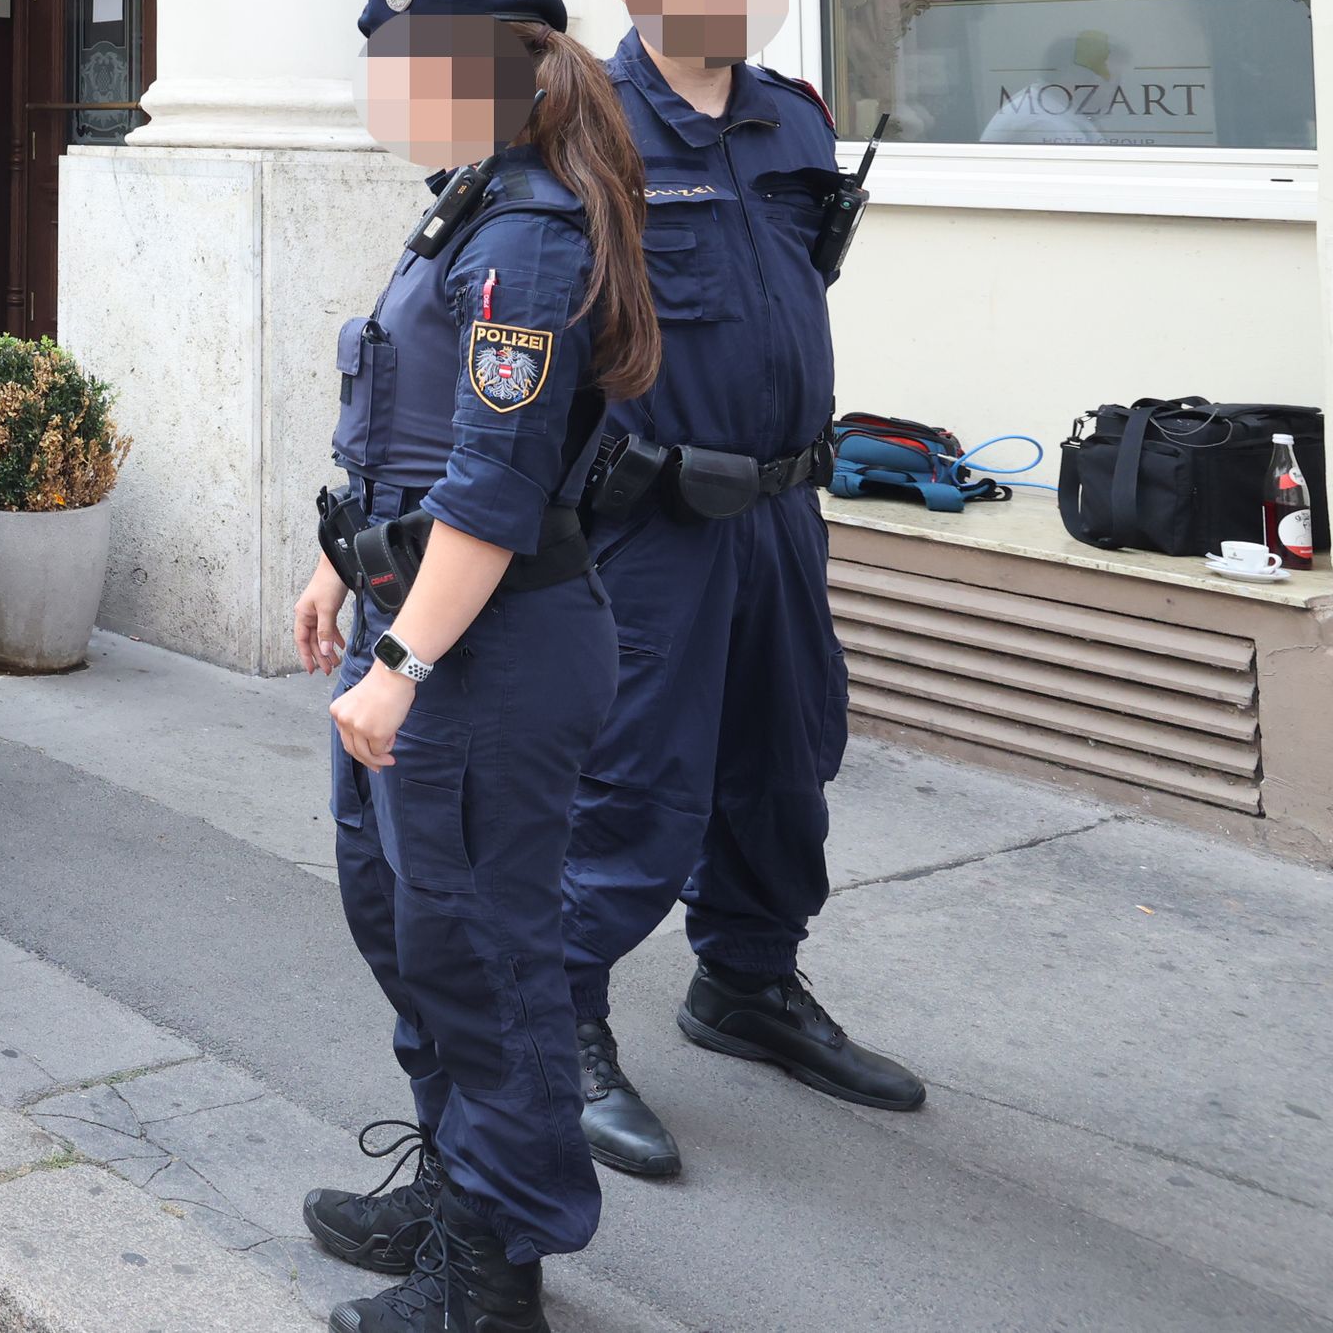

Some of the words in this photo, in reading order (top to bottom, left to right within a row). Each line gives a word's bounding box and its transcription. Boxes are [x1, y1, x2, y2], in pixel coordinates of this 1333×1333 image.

[998, 83, 1206, 116] MOZART
[635, 184, 717, 198] OLIZEI
[476, 327, 544, 351] POLIZEI
